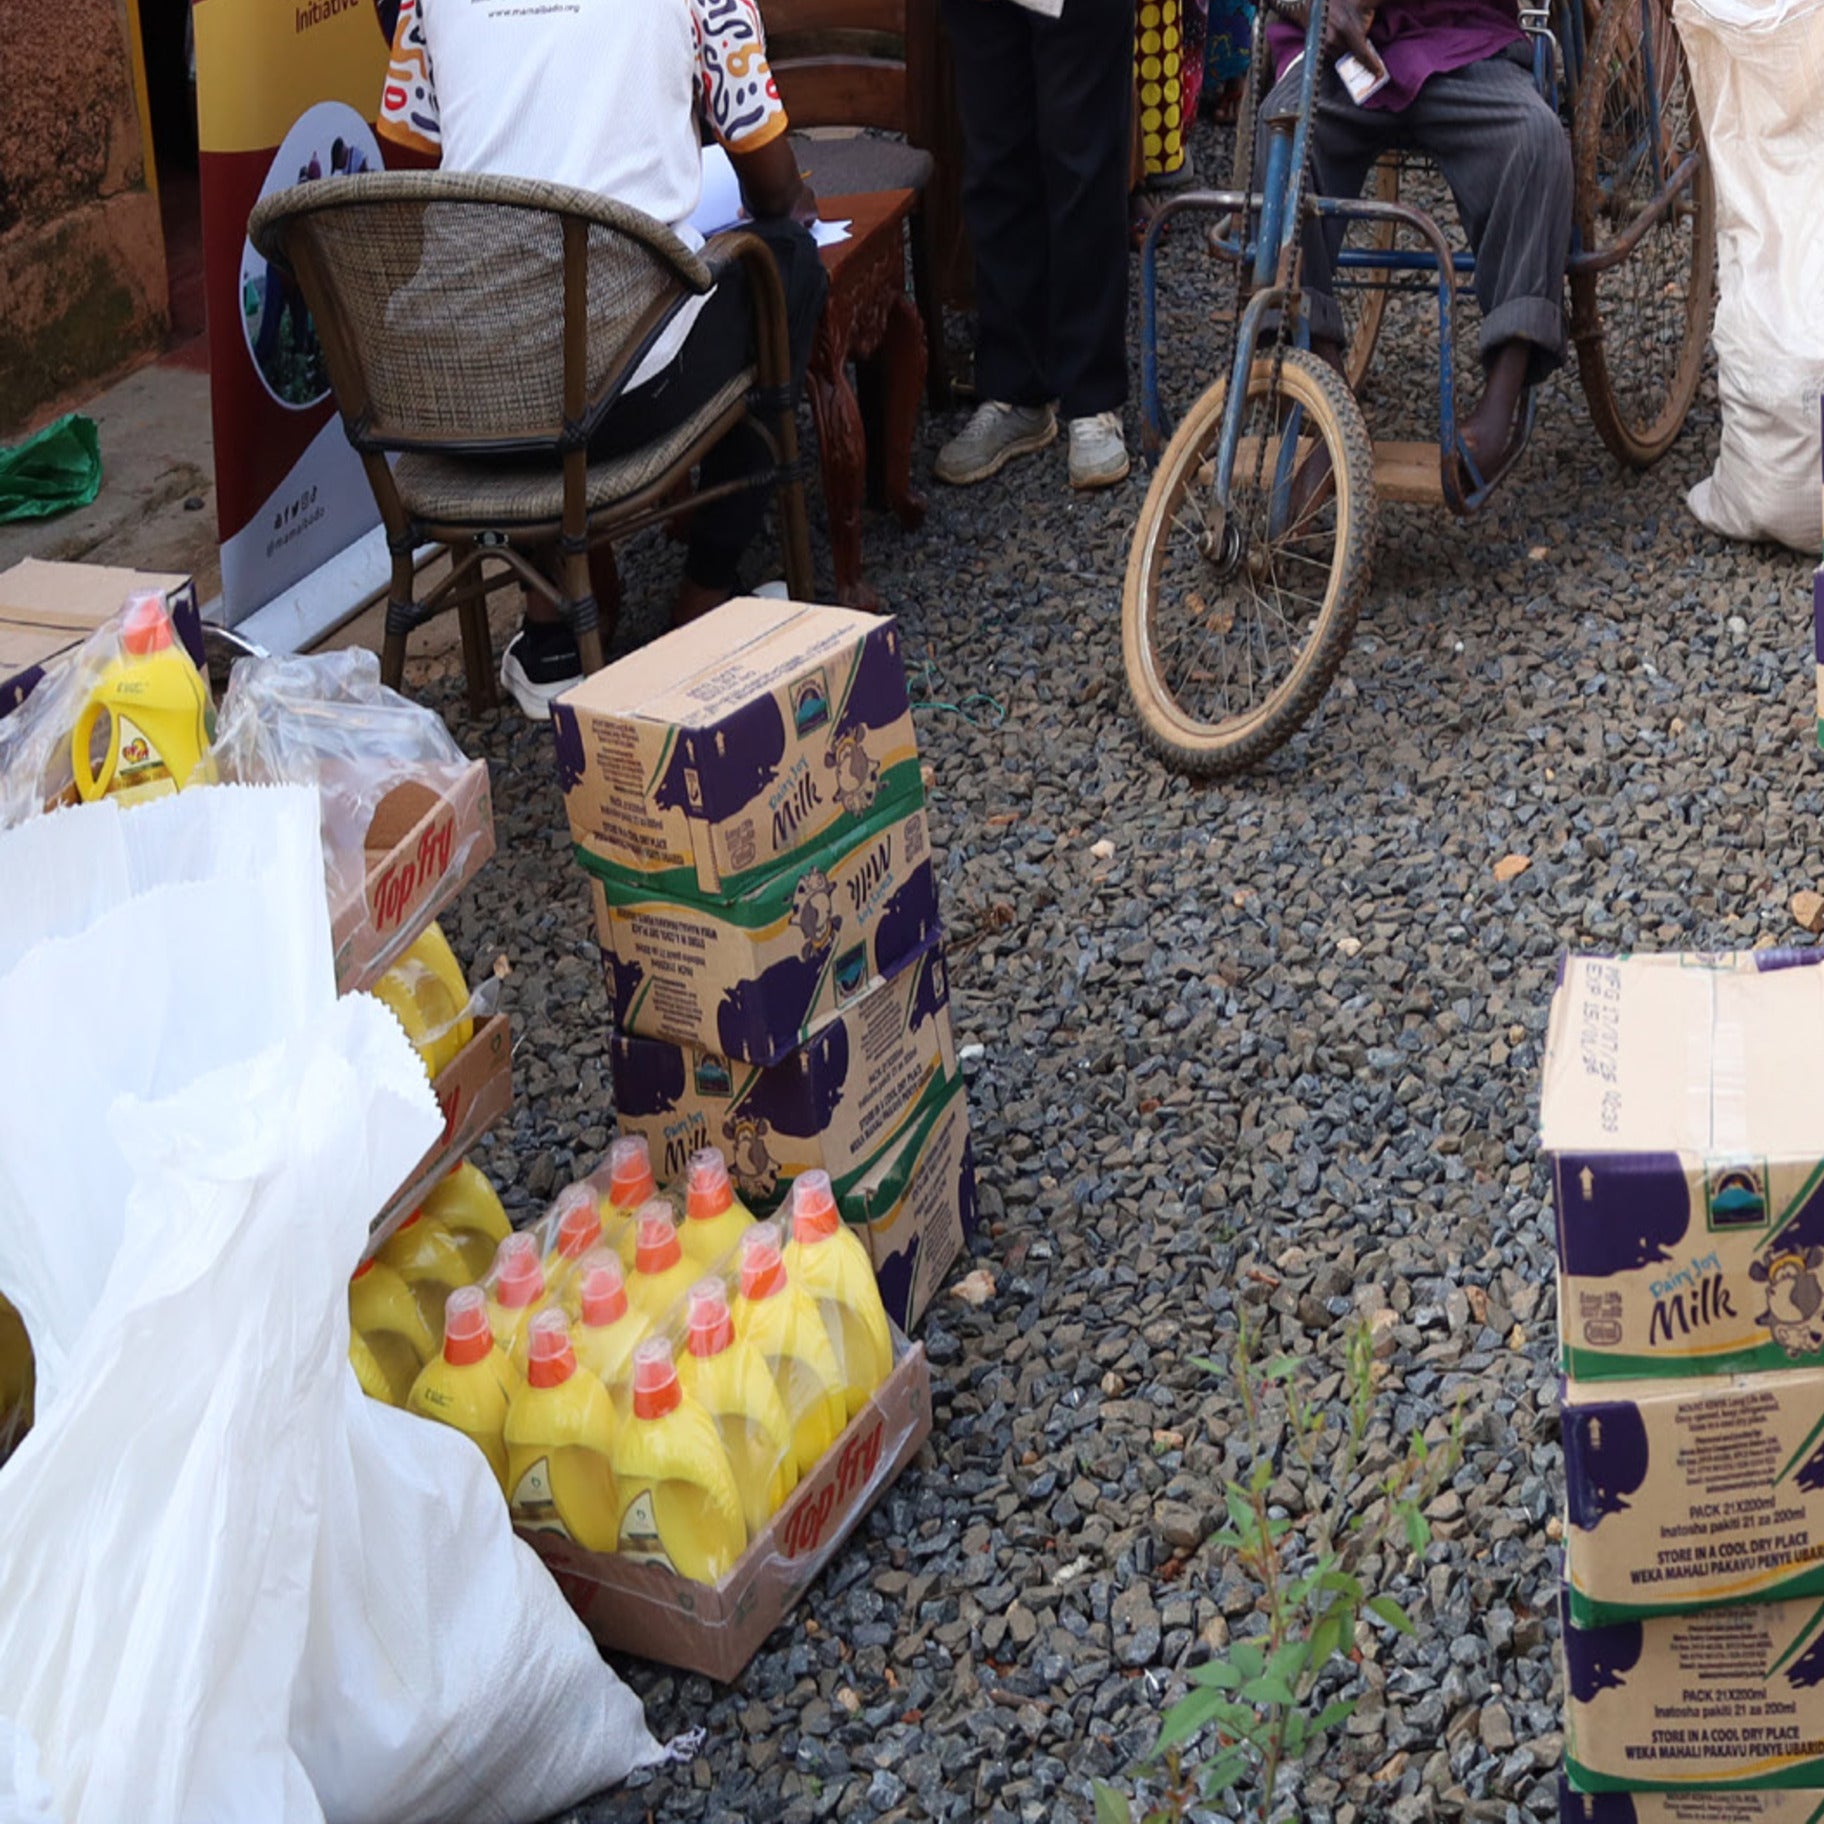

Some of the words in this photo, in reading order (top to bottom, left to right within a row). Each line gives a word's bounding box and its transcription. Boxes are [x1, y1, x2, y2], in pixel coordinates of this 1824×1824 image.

[772, 771, 823, 851] Milk
[373, 862, 416, 931] Top
[416, 818, 456, 887] Fry
[847, 834, 891, 911] Milk
[1649, 1268, 1695, 1299] Dairy
[1690, 1250, 1722, 1278] Joy
[1649, 1272, 1738, 1347] Milk
[784, 1484, 835, 1561] Top
[836, 1420, 884, 1505] Fry
[1660, 1524, 1707, 1539] Inatosha
[1742, 1515, 1755, 1529] 21
[1773, 1506, 1806, 1524] 200ml
[1689, 1504, 1720, 1520] PACK
[1657, 1547, 1693, 1565] STORE
[1695, 1547, 1707, 1560] IN
[1708, 1545, 1717, 1558] A
[1718, 1541, 1748, 1557] COOL
[1750, 1537, 1772, 1553] DRY
[1774, 1531, 1809, 1548] PLACE
[1630, 1568, 1664, 1585] WEKA
[1665, 1563, 1709, 1581] MAHALI
[1711, 1557, 1756, 1574] PAKAVU
[1757, 1550, 1792, 1568] PENYE
[1655, 1704, 1700, 1719] Inatosha
[1702, 1703, 1732, 1719] pakiti
[1734, 1703, 1746, 1716] 21
[1764, 1701, 1796, 1716] 200ml
[1682, 1688, 1713, 1702] PACK
[1715, 1687, 1767, 1702] 21X200ml
[1625, 1745, 1657, 1759] WEKA
[1659, 1744, 1700, 1758] MAHALI
[1703, 1743, 1746, 1757] PAKAVU
[1749, 1742, 1784, 1757] PENYE
[1652, 1729, 1685, 1744] STORE
[1688, 1729, 1700, 1743] IN
[1701, 1729, 1709, 1742] A
[1711, 1728, 1740, 1742] COOL
[1742, 1727, 1763, 1741] DRY
[1765, 1726, 1800, 1740] PLACE
